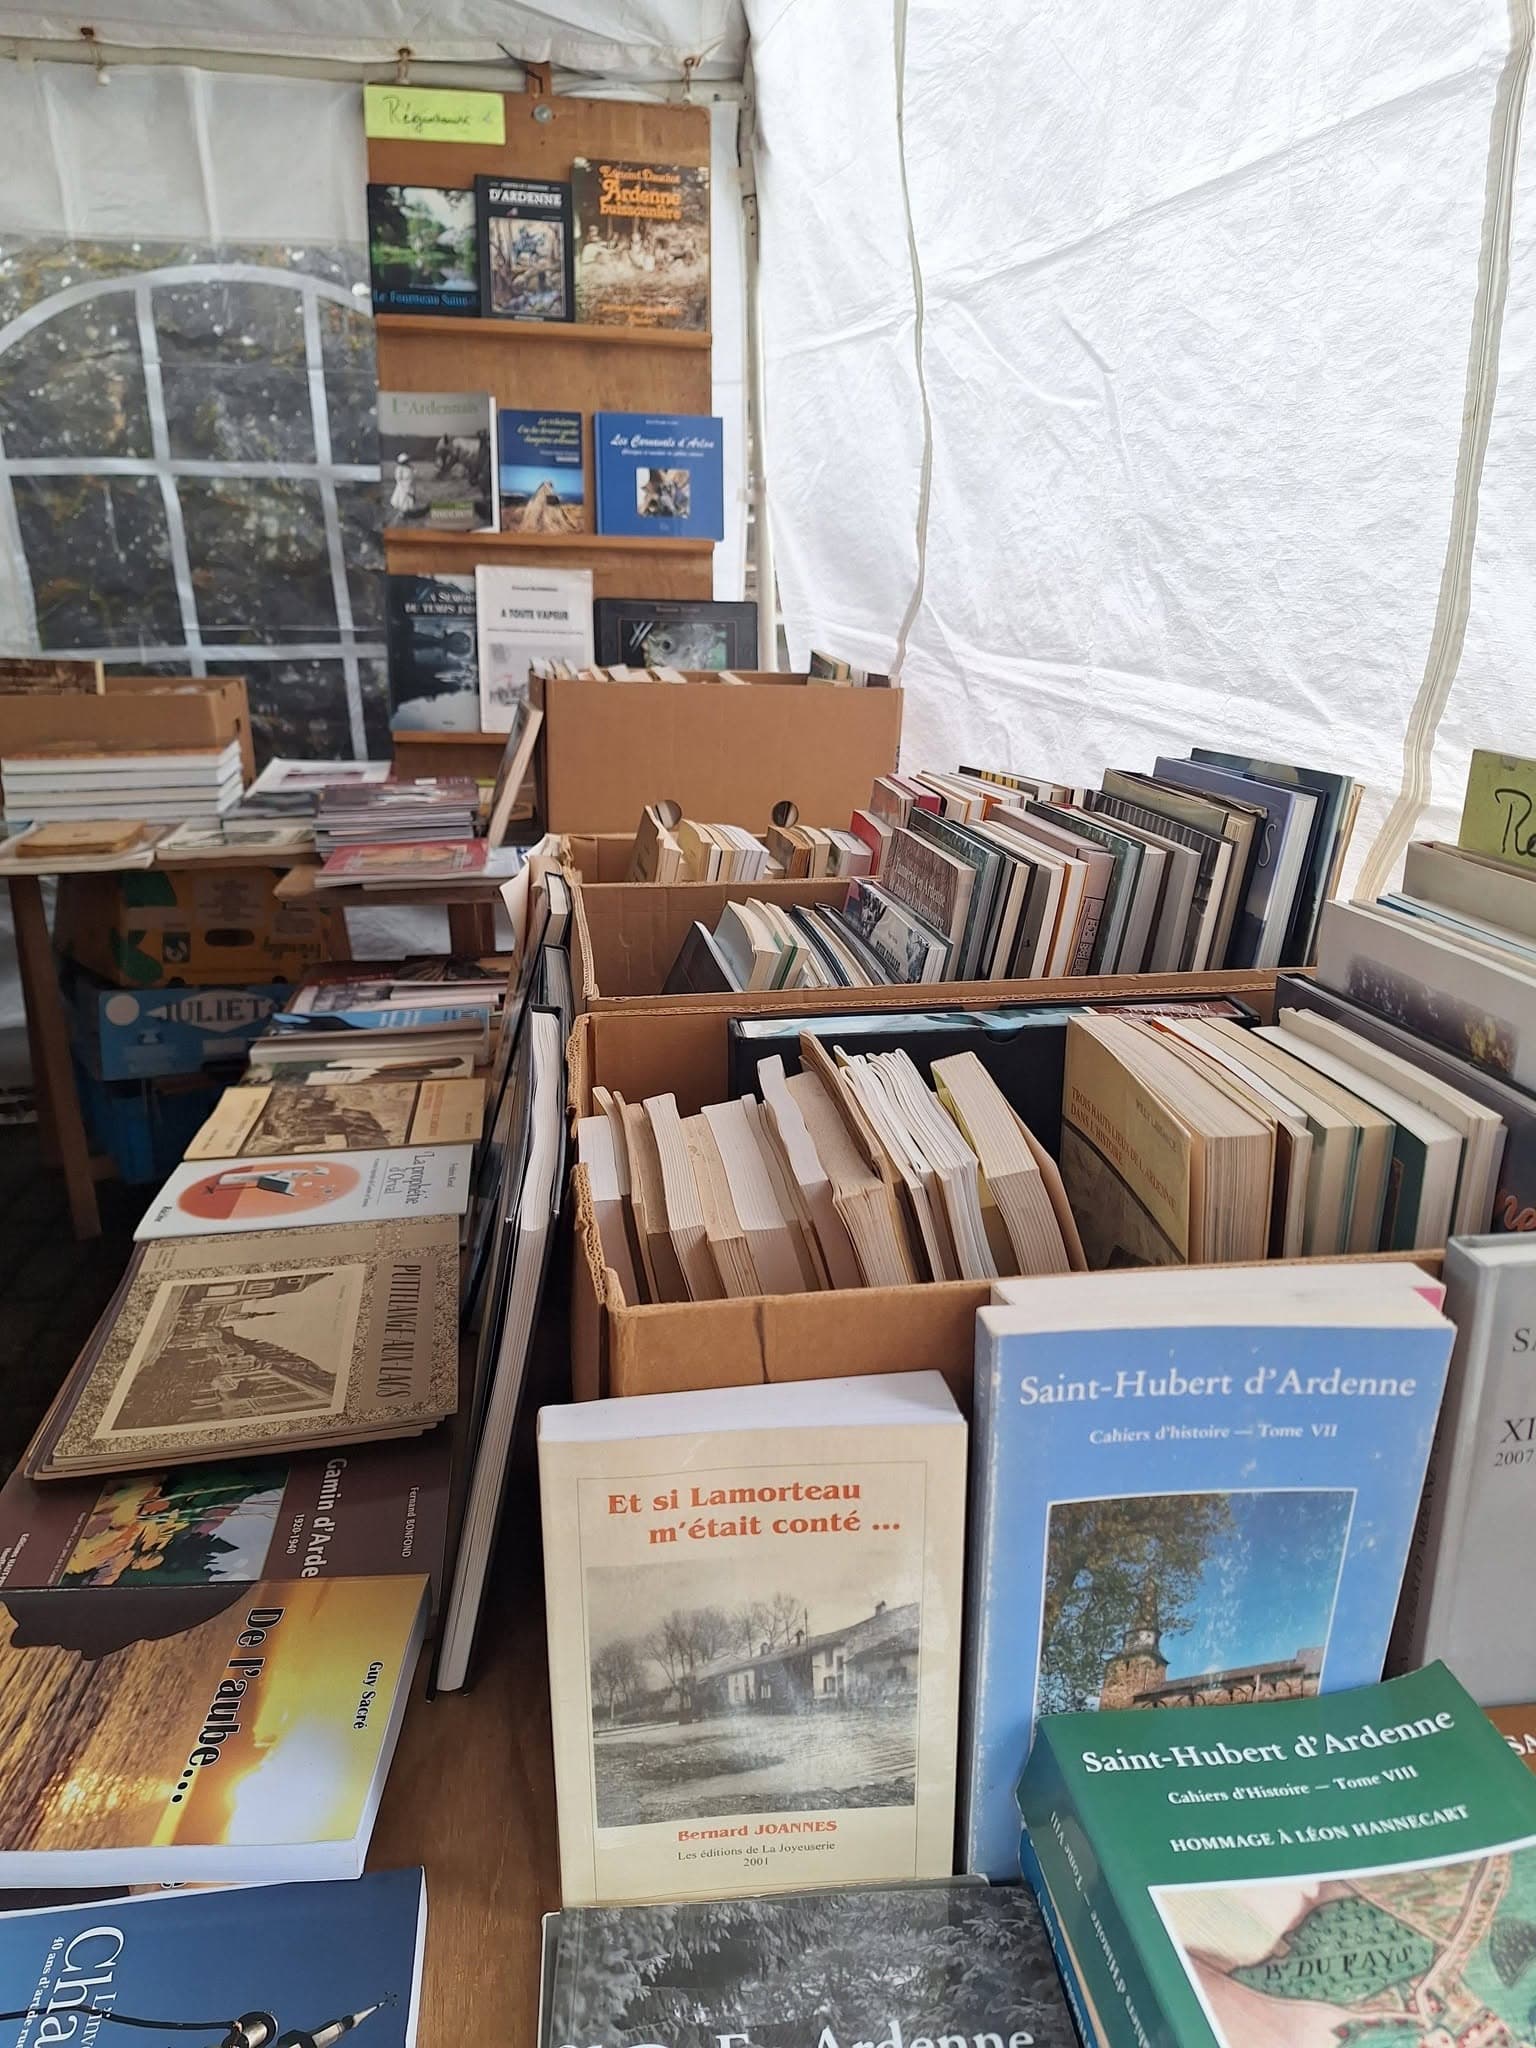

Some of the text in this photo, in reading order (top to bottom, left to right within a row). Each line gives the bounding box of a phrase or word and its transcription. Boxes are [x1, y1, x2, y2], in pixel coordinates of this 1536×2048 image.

[489, 188, 562, 207] D'ARDENNE
[600, 178, 681, 205] Ardenne
[509, 609, 533, 620] TOUTE
[535, 610, 569, 621] VAPEUR
[1071, 1102, 1089, 1125] DANS
[1072, 1086, 1091, 1110] TROIS
[1091, 1101, 1112, 1131] HAUTS
[1111, 1121, 1130, 1152] LIEUX
[405, 1165, 432, 1205] prophétie
[375, 1264, 422, 1398] PUTTELANGE-AUX-LACS
[1020, 1366, 1418, 1405] Saint-Hubert d'Ardenne
[1089, 1427, 1151, 1445] Cahiers
[1155, 1424, 1230, 1441] d'histoire
[1257, 1423, 1303, 1439] Tome
[1310, 1422, 1338, 1439] VII
[317, 1458, 348, 1511] Gamin
[608, 1481, 861, 1514] Et si Lamorteau
[286, 1514, 305, 1554] 1920-1940
[402, 1486, 420, 1557] Fernand BONFOND
[649, 1515, 762, 1544] m'était
[772, 1510, 861, 1534] conté
[237, 1607, 286, 1648] De
[353, 1660, 384, 1730] Guy Sacré
[1081, 1711, 1456, 1774] Saint-Hubert d'Ardenne
[1167, 1784, 1229, 1805] Cahiers
[1232, 1780, 1311, 1801] d'Histoire
[1333, 1774, 1381, 1791] Tome
[1381, 1764, 1420, 1784] VIII
[678, 1820, 838, 1842] Bernard JOANNES
[1050, 1809, 1065, 1848] VIII
[1170, 1804, 1470, 1853] HOMMAGE À LÉON HANNECART
[678, 1840, 836, 1860] Les éditions de La Joyeuserie
[743, 1857, 769, 1866] 2001
[1064, 1844, 1084, 1891] Tome
[51, 1936, 65, 1950] 40
[1090, 1909, 1126, 1994] d'Histoire
[42, 1952, 56, 1976] ans
[1298, 1958, 1331, 1977] DU
[23, 2008, 39, 2026] de
